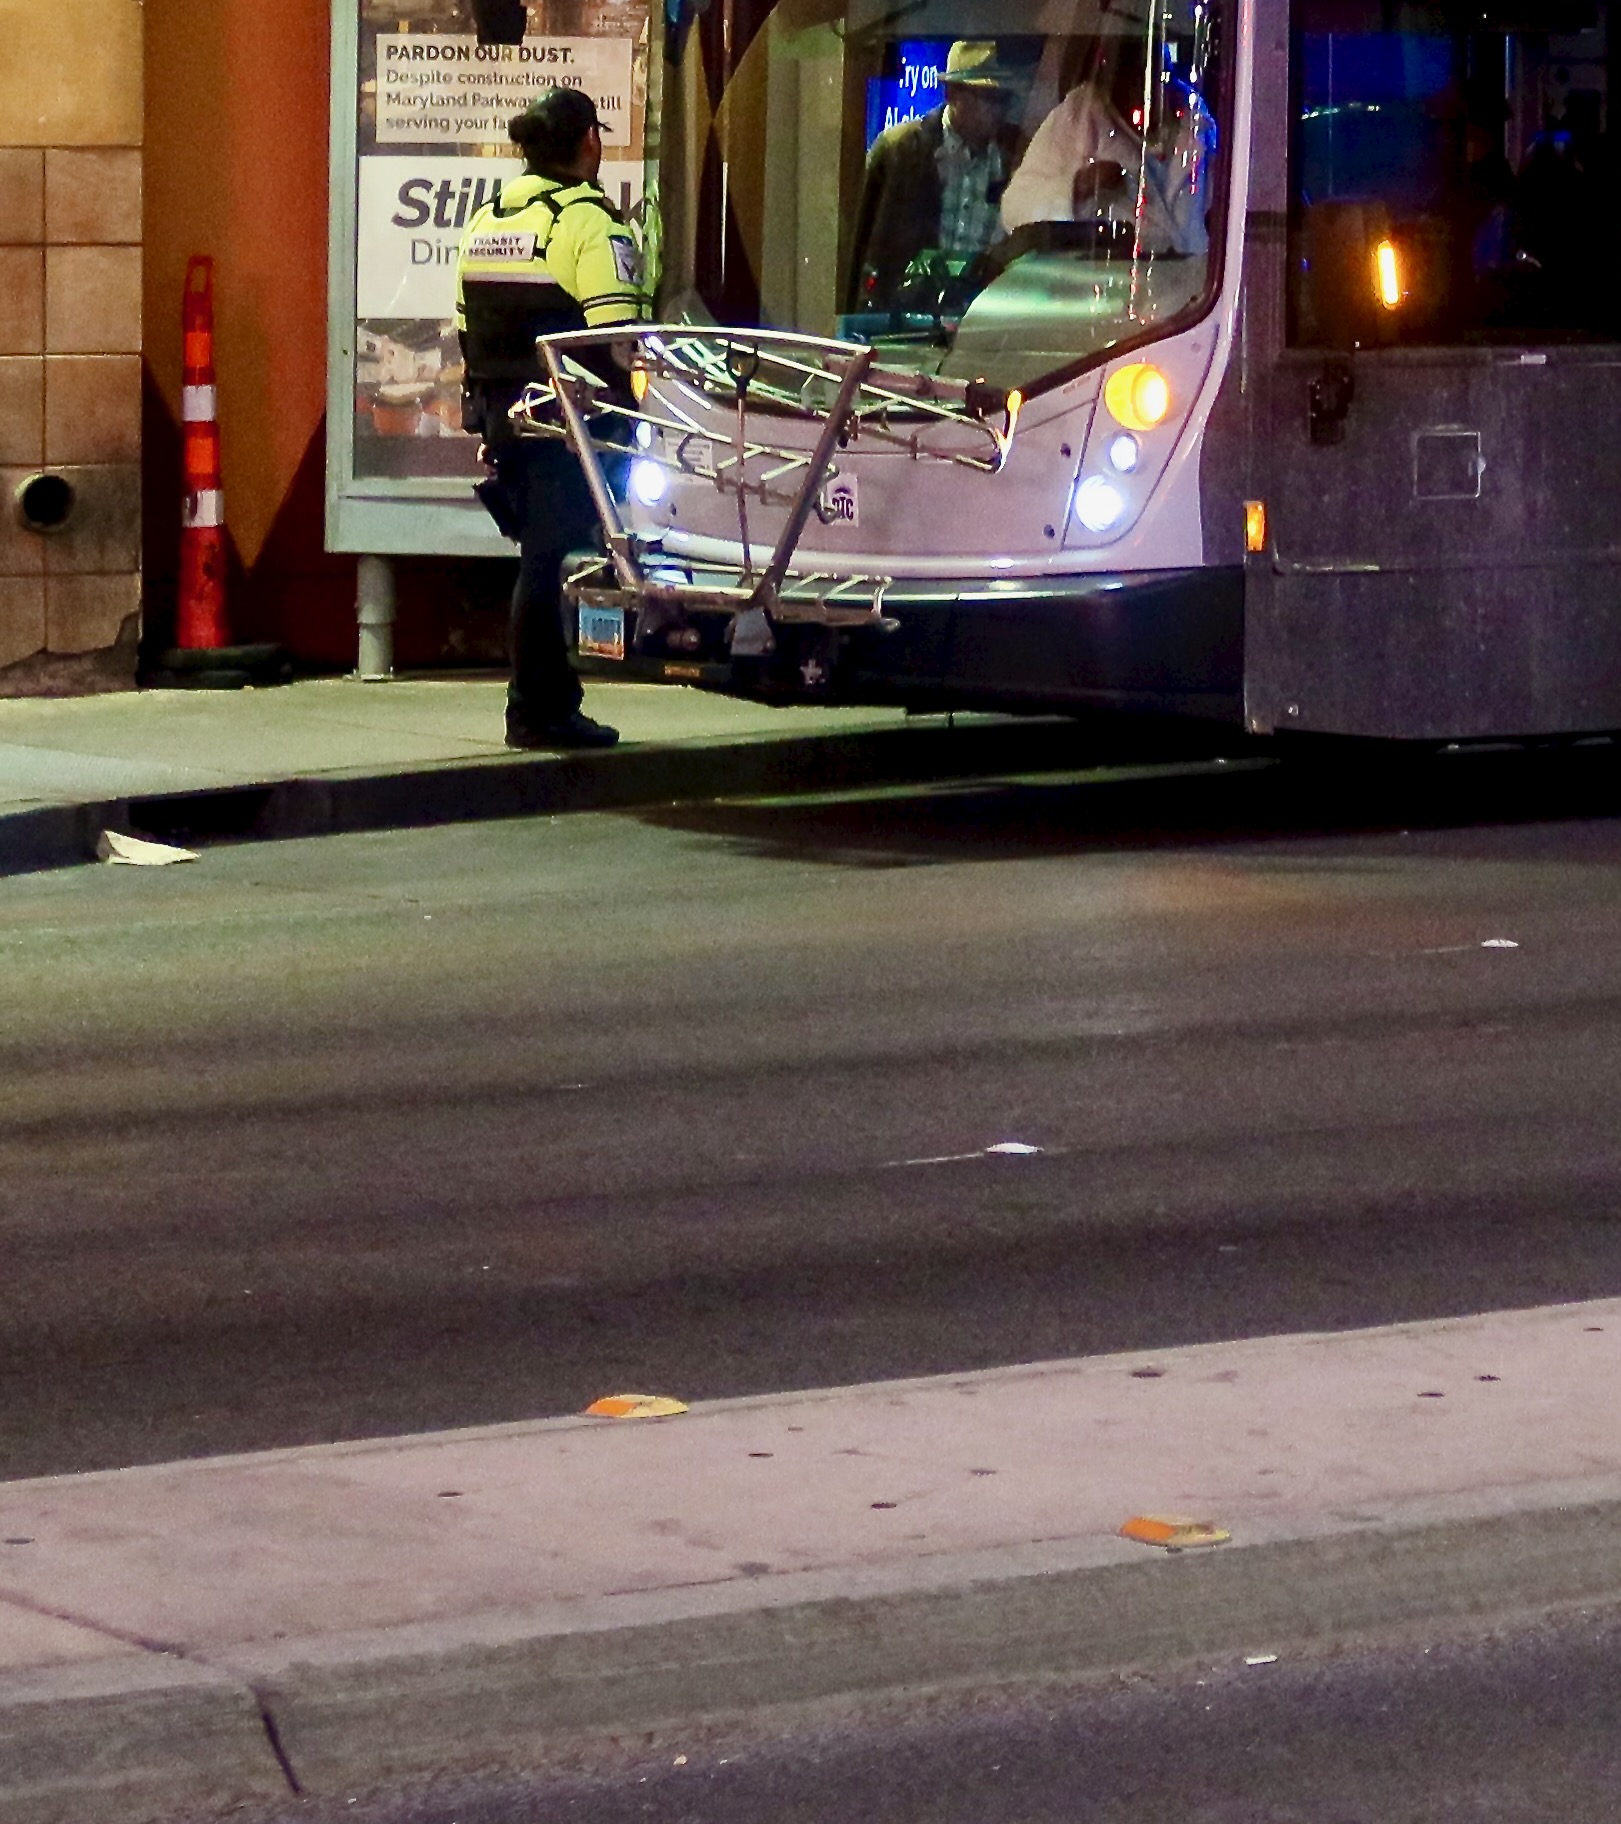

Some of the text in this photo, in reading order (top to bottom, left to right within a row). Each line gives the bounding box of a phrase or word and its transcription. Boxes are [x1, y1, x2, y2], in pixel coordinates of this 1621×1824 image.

[386, 44, 575, 65] PARDON OUR DUST.
[386, 68, 583, 88] Despite construction on
[386, 91, 469, 111] Maryland
[386, 115, 451, 134] serving
[455, 117, 490, 135] your
[467, 246, 526, 257] SECURITY
